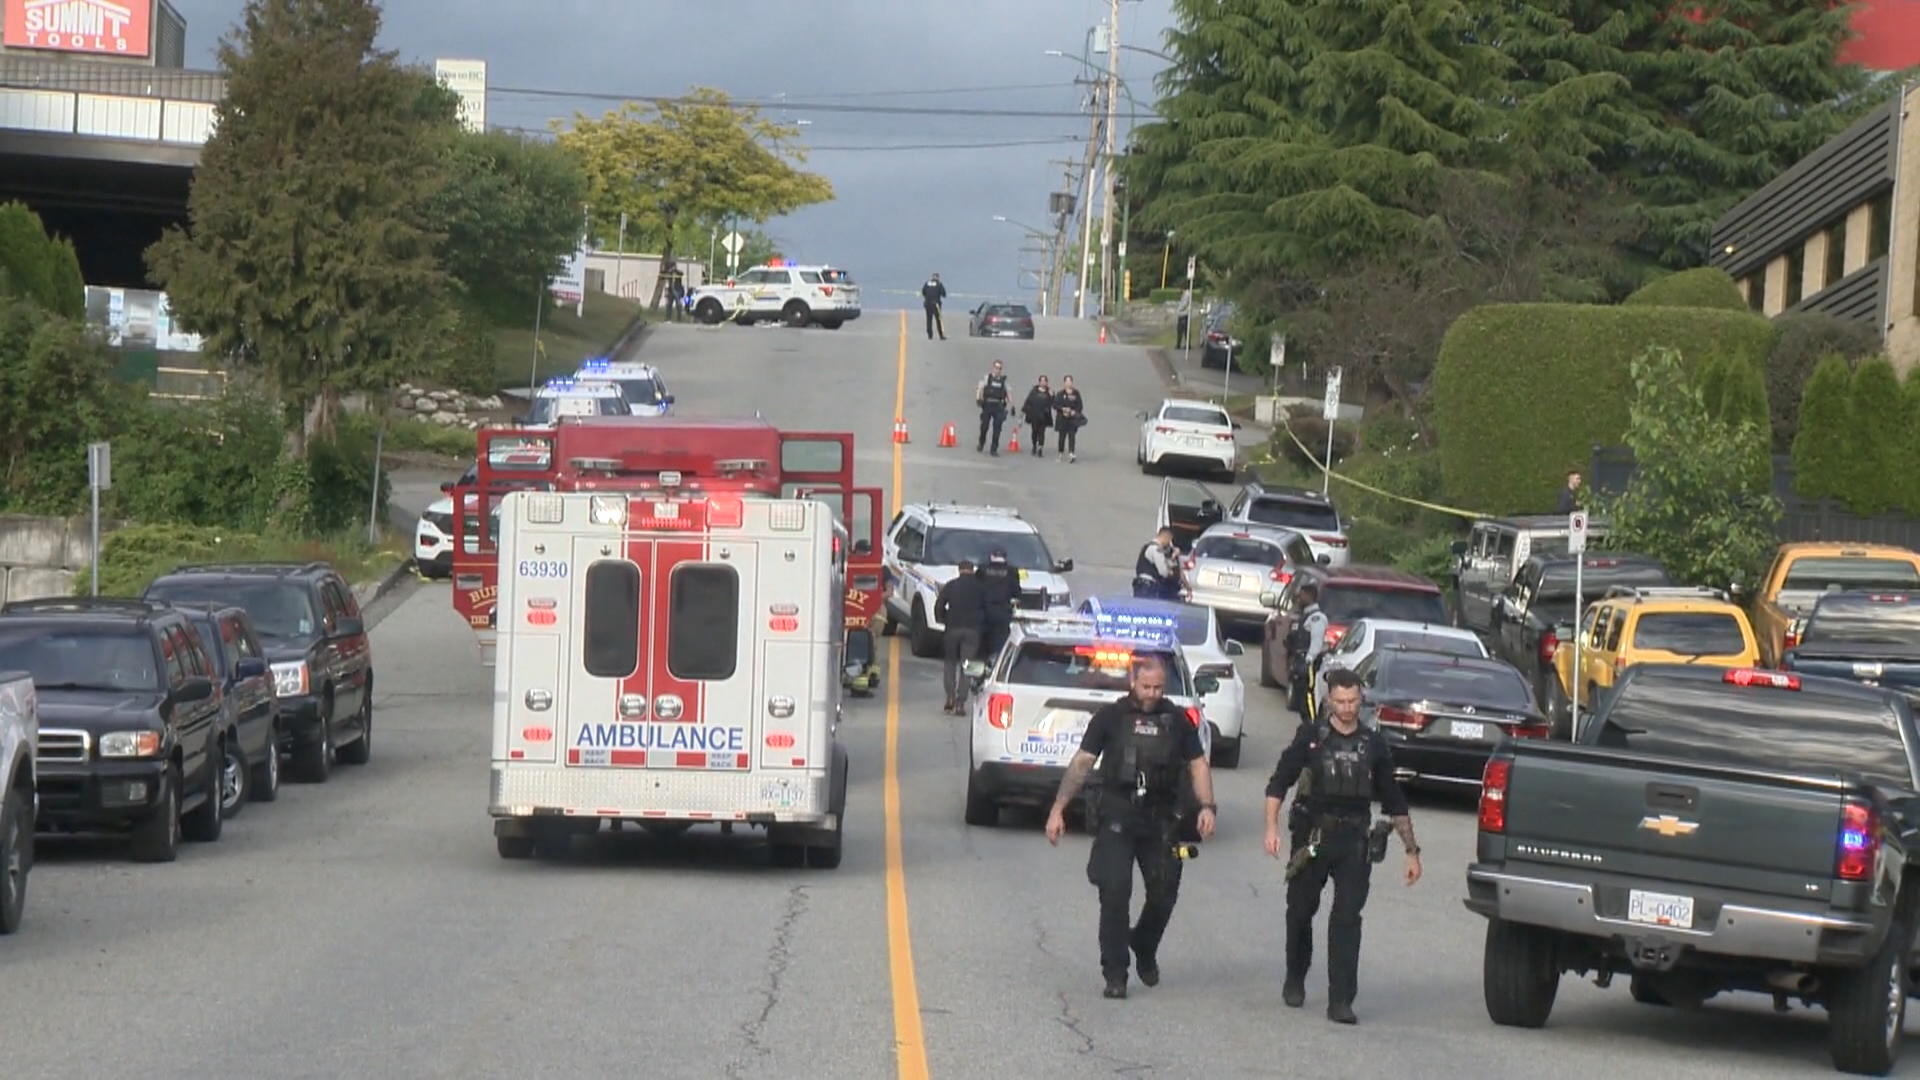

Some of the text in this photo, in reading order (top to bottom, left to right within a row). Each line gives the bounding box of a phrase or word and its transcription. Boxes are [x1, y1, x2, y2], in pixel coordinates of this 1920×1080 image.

[25, 1, 129, 37] SUMMIT
[26, 31, 127, 51] TOOLS
[519, 561, 568, 578] 63930
[576, 723, 743, 750] AMBULANCE
[1020, 742, 1066, 756] BU5027
